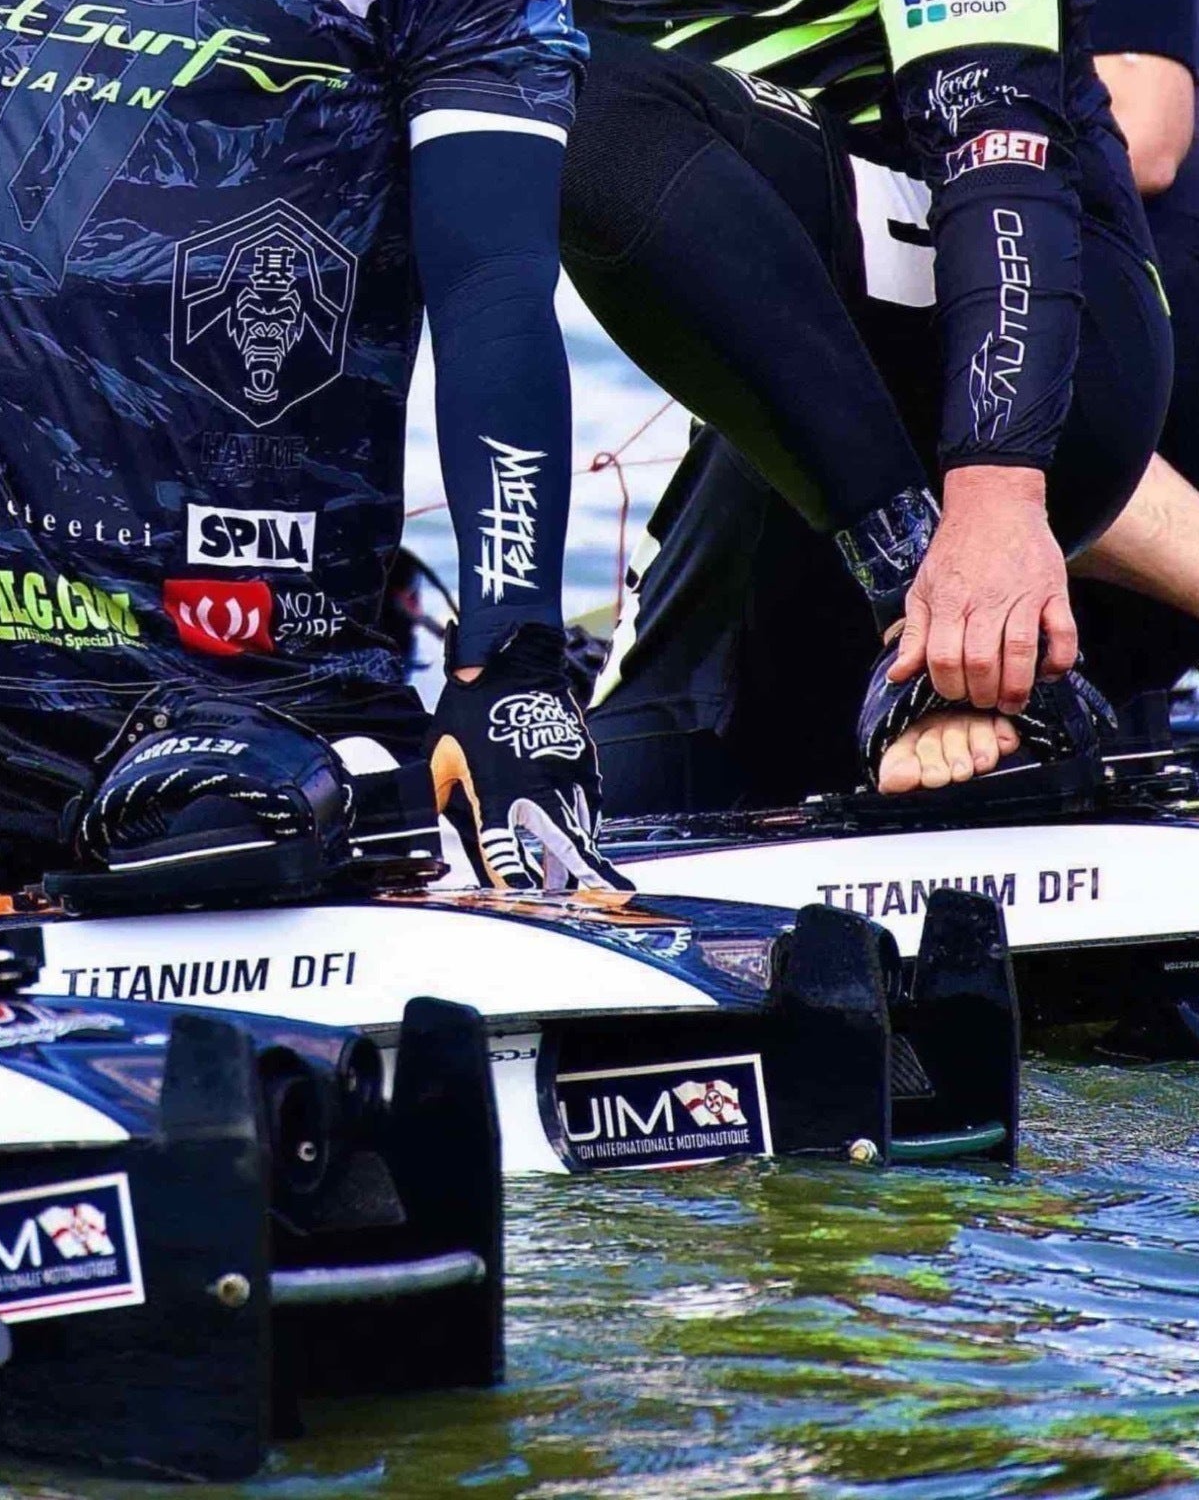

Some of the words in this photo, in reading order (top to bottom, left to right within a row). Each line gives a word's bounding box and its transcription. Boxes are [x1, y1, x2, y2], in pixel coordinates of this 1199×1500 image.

[950, 0, 1007, 18] group
[1, 66, 166, 109] JAPAN
[249, 247, 297, 292] 基
[64, 632, 115, 650] Special
[1038, 867, 1099, 904] DFI
[62, 957, 270, 1001] TiTANIUM
[290, 951, 356, 989] DFI
[596, 1134, 674, 1159] INTERNATIONALE
[676, 1129, 751, 1152] MOTONAUTIQUE
